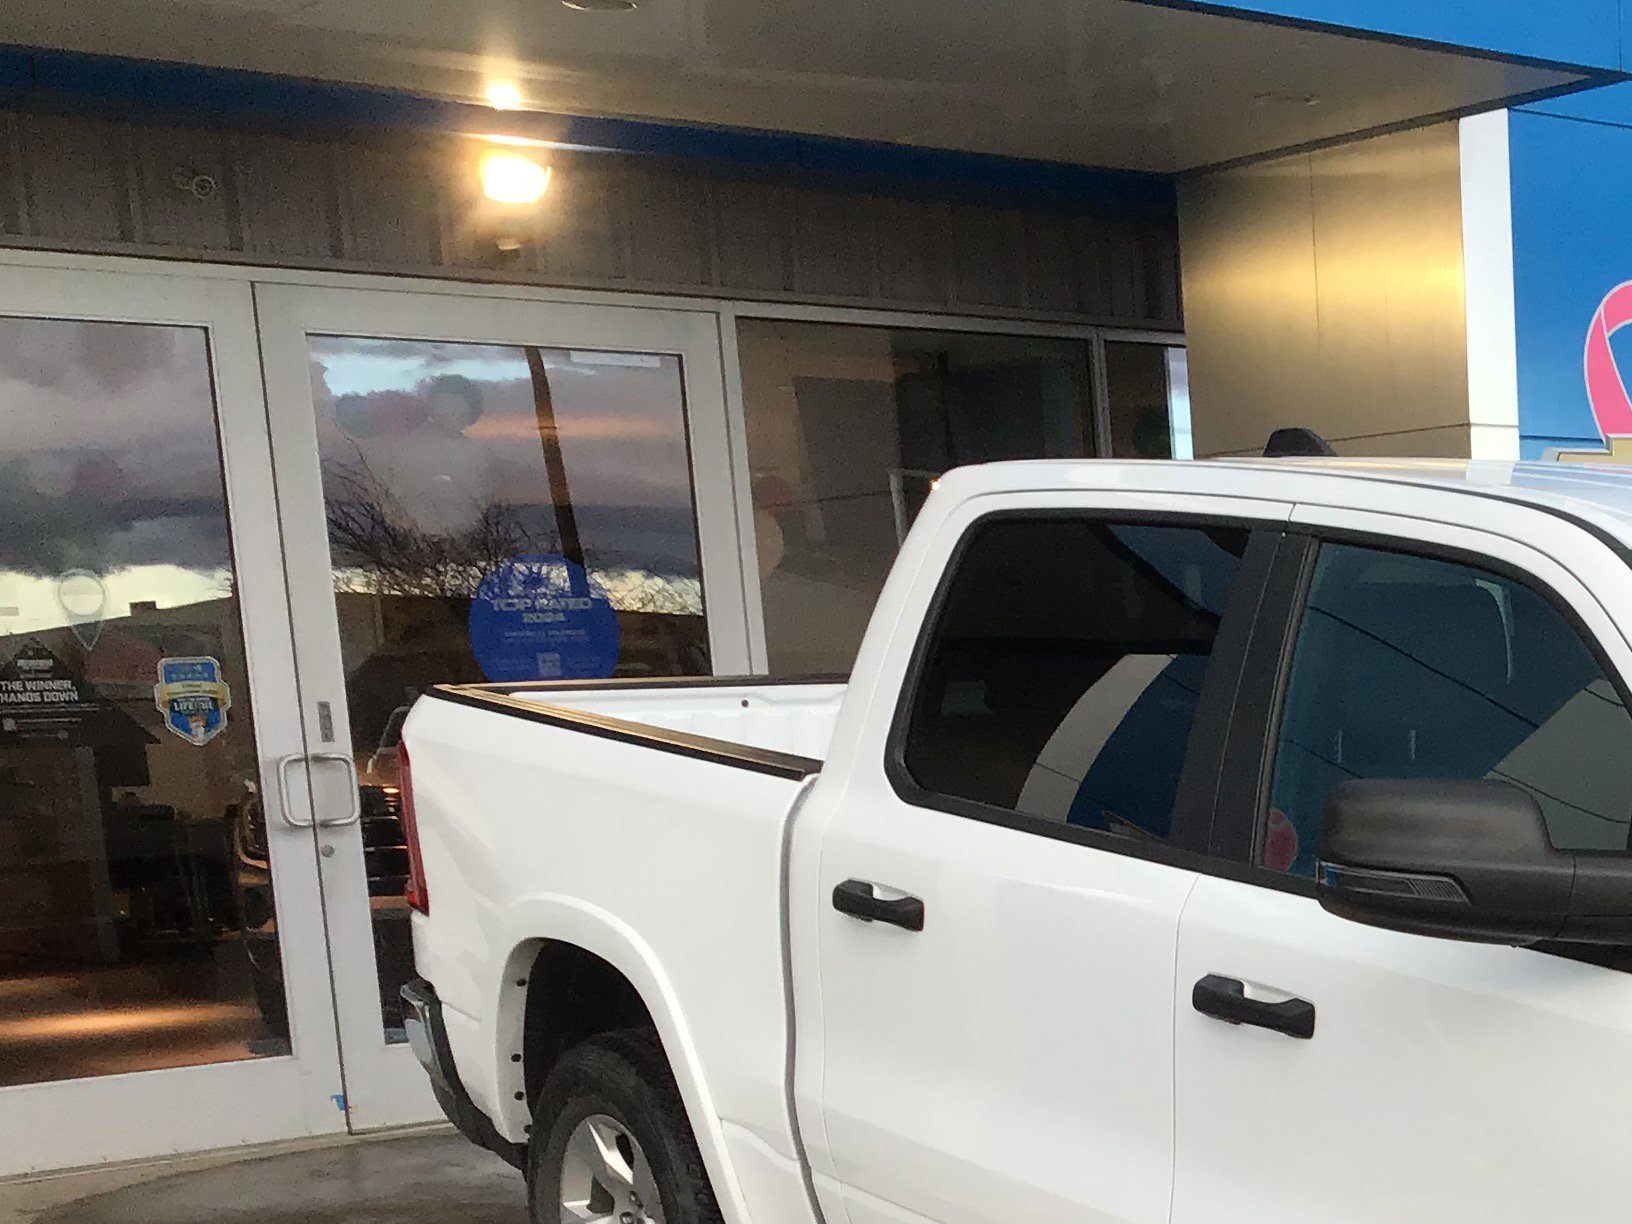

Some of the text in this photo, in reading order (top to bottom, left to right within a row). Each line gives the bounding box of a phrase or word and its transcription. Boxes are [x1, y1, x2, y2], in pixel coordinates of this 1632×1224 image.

[0, 681, 23, 691] THE
[0, 691, 79, 703] HANDS DOWN
